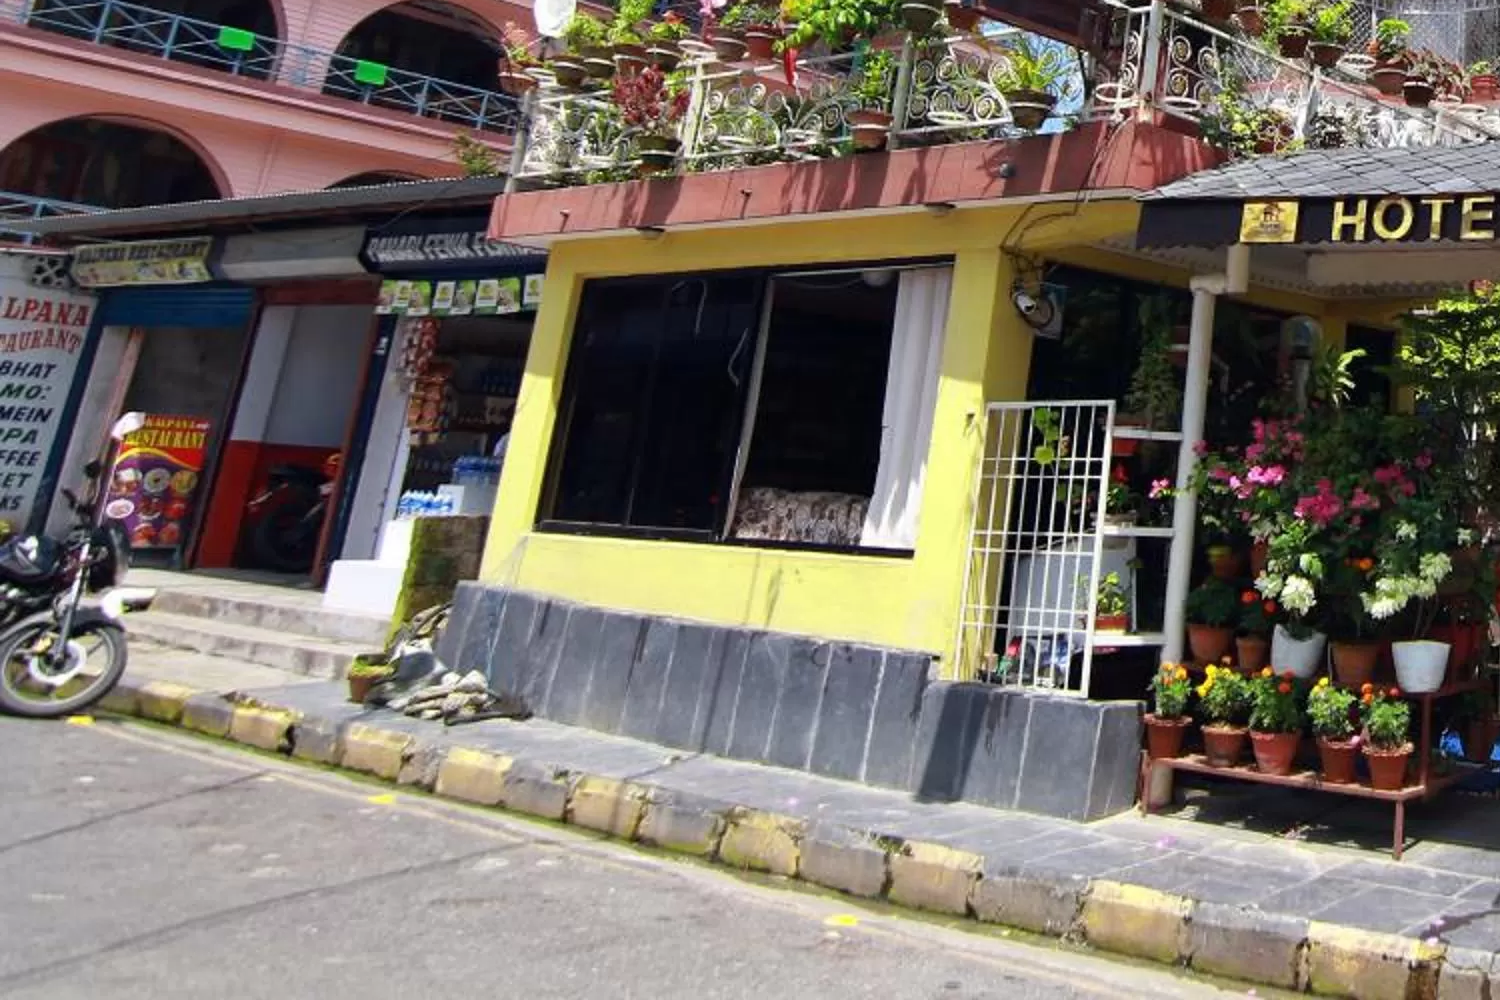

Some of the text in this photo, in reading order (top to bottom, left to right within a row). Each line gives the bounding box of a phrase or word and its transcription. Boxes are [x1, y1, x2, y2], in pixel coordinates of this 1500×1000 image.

[0, 295, 90, 326] LPANA
[0, 360, 57, 379] BHAT
[0, 427, 38, 445] PA
[0, 472, 33, 489] ET
